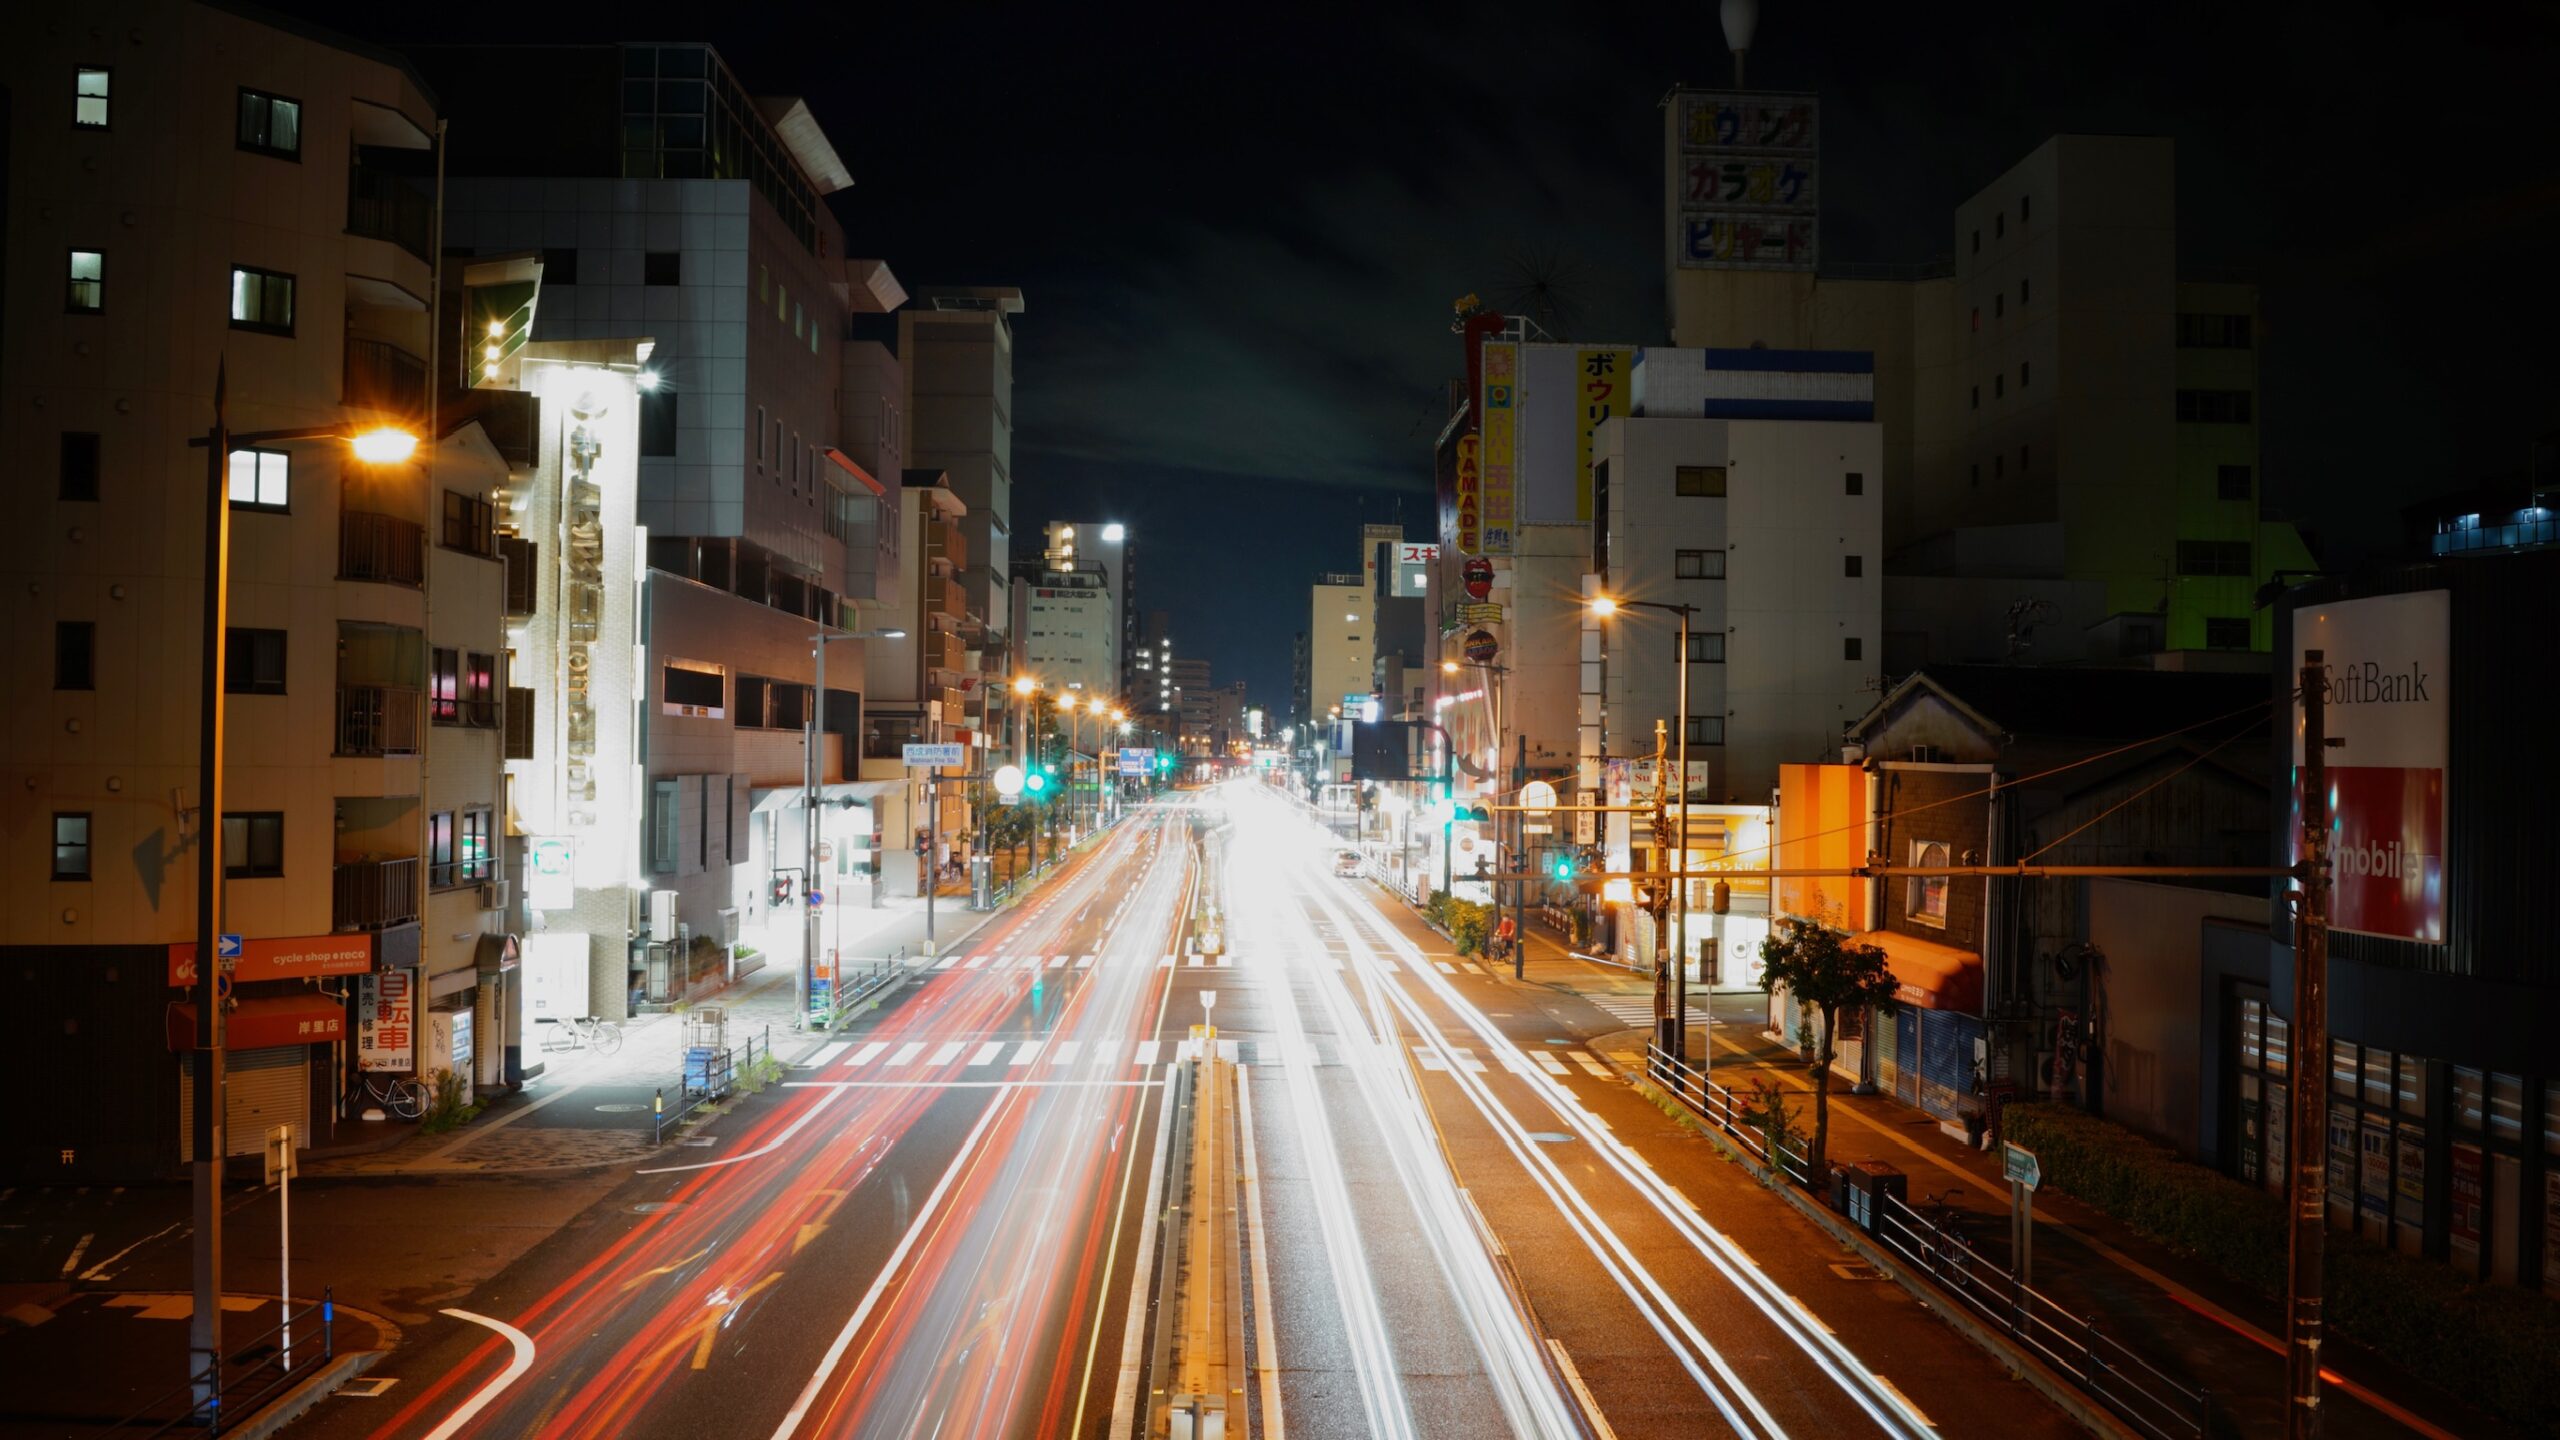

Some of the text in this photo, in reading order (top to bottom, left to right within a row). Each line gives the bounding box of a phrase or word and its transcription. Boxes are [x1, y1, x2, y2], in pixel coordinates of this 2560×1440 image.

[1689, 106, 1808, 145] ボウリング
[1689, 163, 1808, 203] カラオケ
[1690, 219, 1809, 262] ビリヤード
[1463, 439, 1479, 547] TAMADE
[2322, 660, 2430, 705] SoftBank
[273, 953, 303, 966] cycle
[305, 951, 331, 962] shop
[298, 1018, 339, 1035] 岸里店
[378, 973, 409, 1052] 自転車
